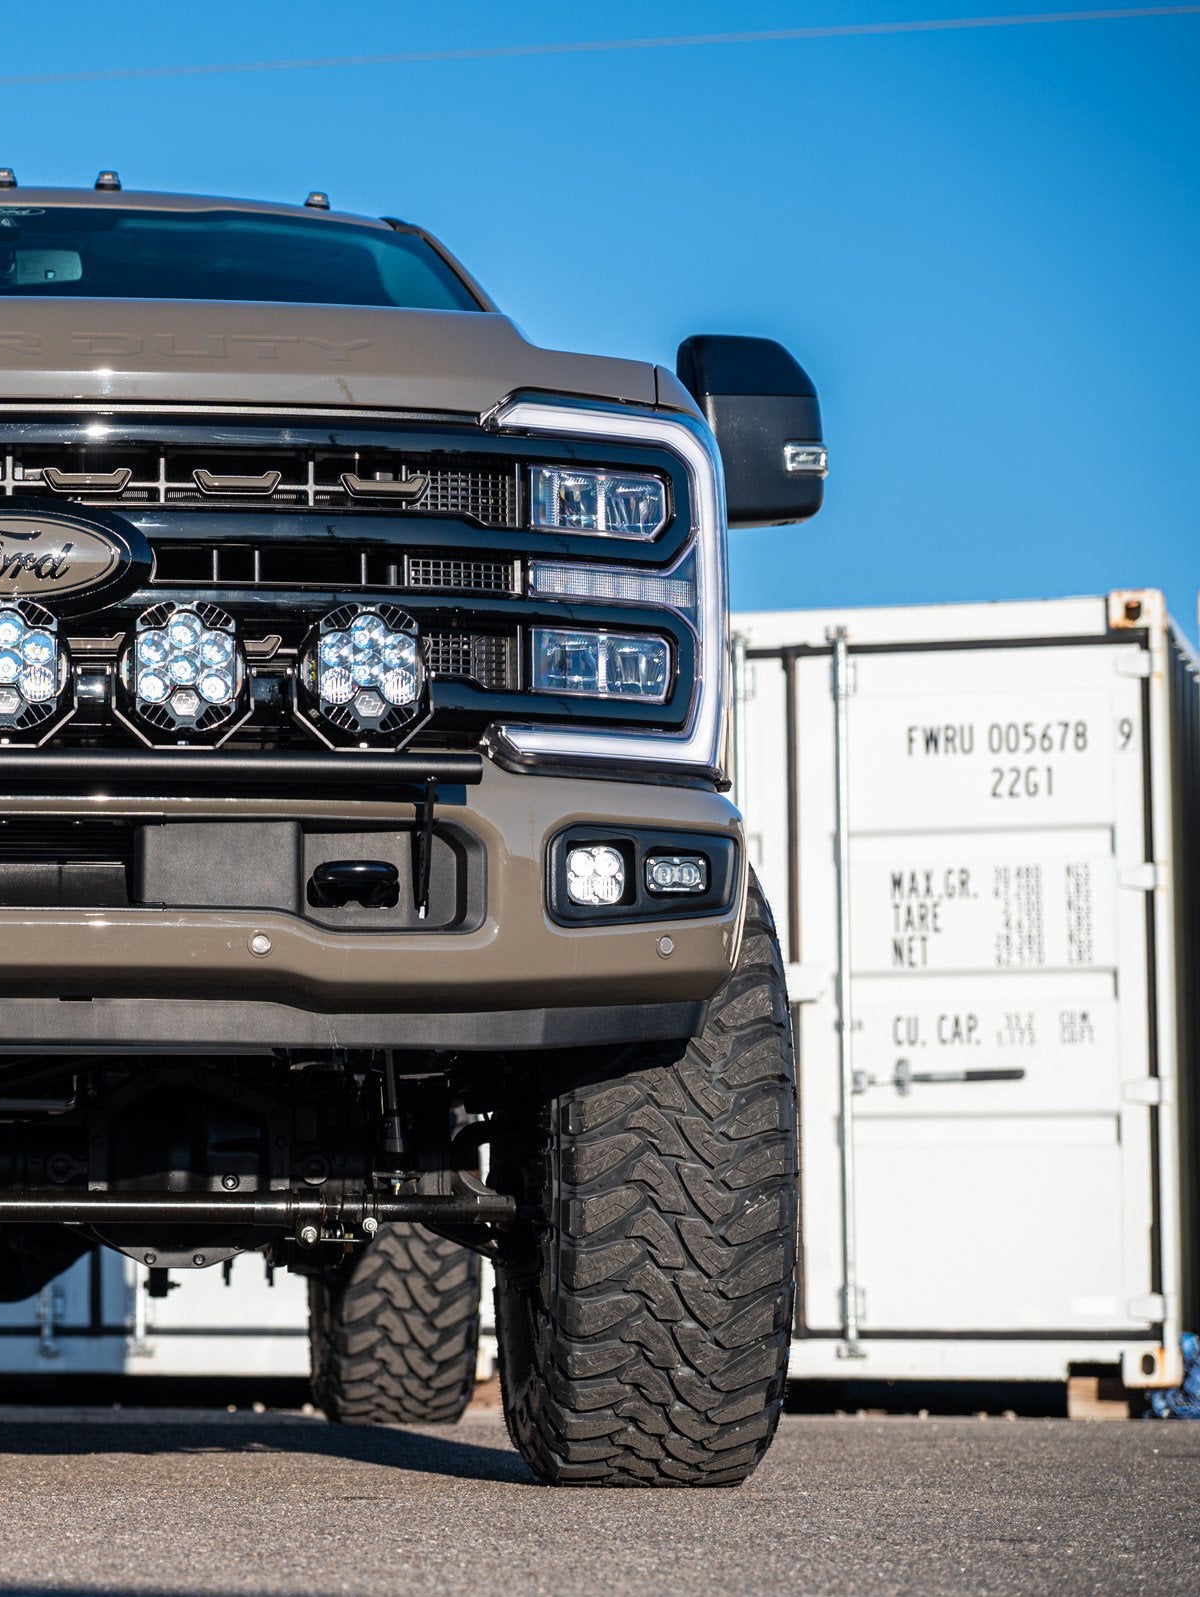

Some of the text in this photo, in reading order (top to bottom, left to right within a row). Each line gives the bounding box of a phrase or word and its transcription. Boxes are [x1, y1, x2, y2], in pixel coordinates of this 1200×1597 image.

[72, 331, 372, 363] DUTY
[906, 717, 1134, 757] FWRU 005678 9
[990, 765, 1054, 799] 22G1
[893, 900, 943, 933] TARE
[891, 934, 928, 968] NET
[891, 1014, 928, 1048] CU.
[936, 1012, 982, 1047] CAP.
